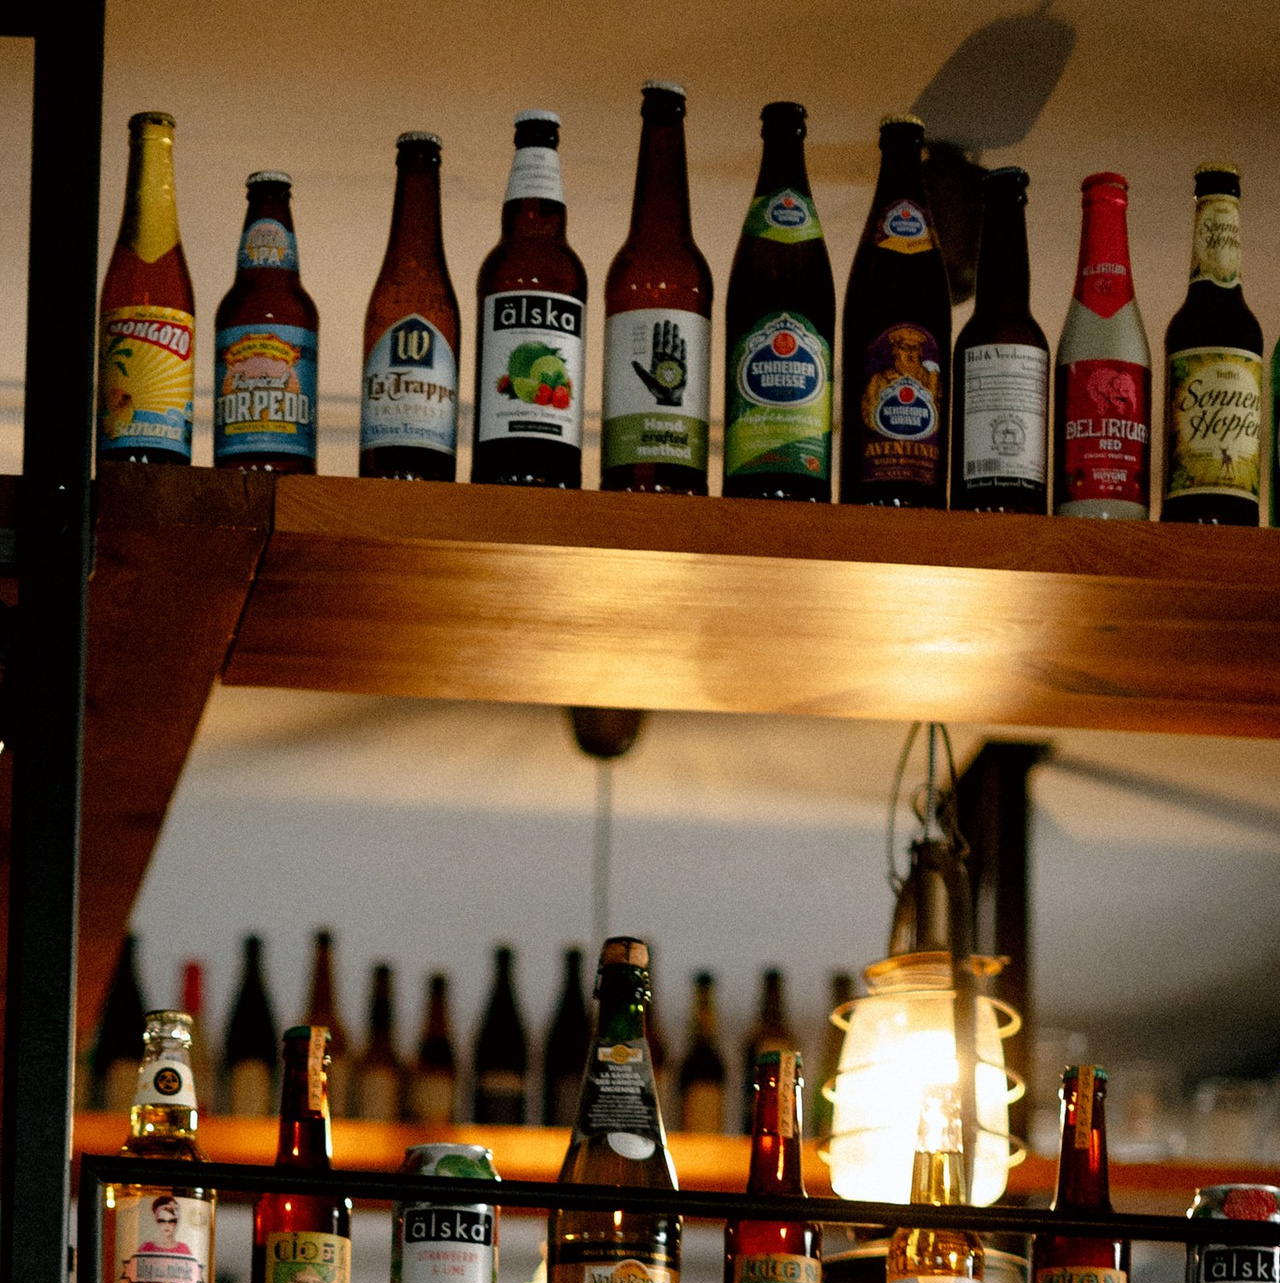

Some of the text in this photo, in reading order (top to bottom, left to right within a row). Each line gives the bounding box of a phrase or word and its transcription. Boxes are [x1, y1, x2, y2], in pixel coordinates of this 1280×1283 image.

[500, 298, 575, 331] älska
[751, 360, 816, 379] SCHNEIDER
[760, 374, 807, 390] WEISSE
[217, 390, 310, 425] TORPEDO
[1180, 379, 1260, 412] Sonnen
[1066, 418, 1148, 444] DELIRIUM
[1099, 439, 1122, 450] RED
[412, 1212, 485, 1242] älska
